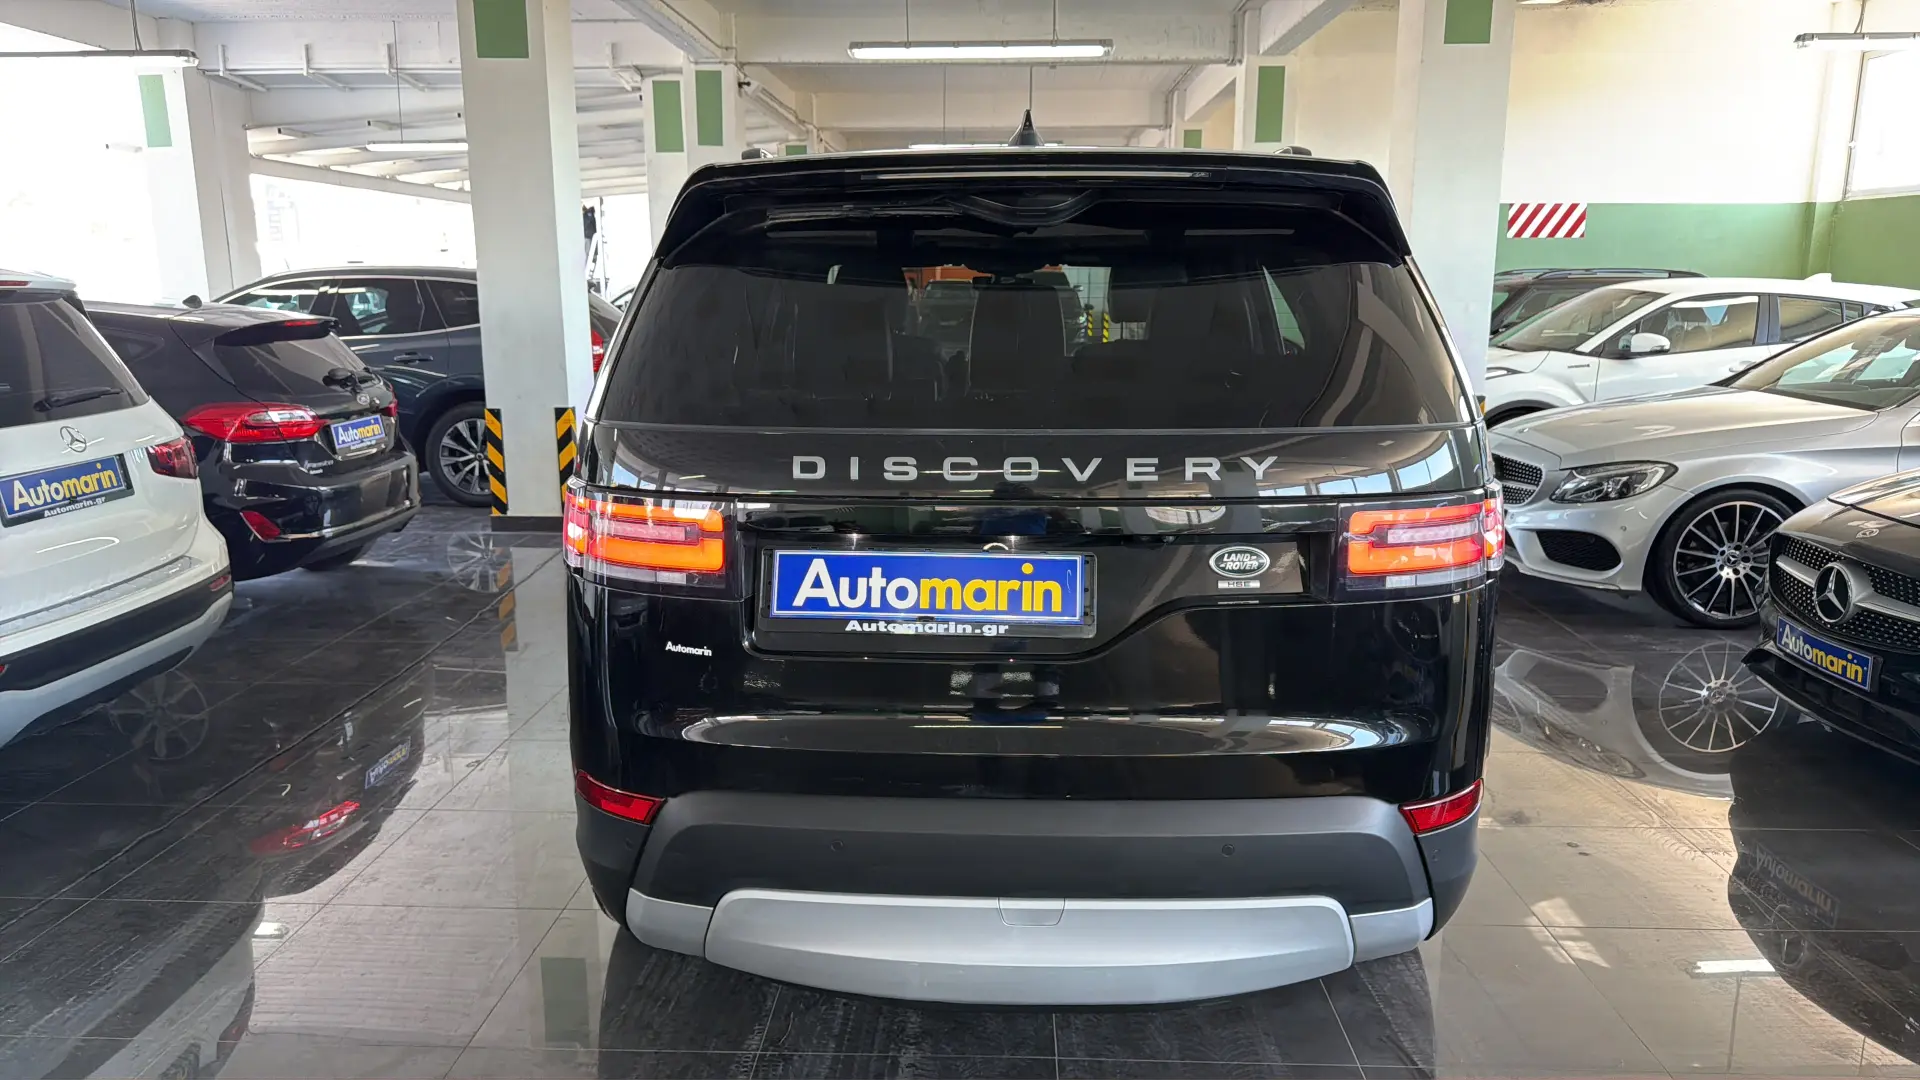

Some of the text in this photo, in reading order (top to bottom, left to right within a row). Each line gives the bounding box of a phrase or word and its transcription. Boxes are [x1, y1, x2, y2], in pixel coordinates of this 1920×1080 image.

[792, 456, 1278, 481] DISCOVERY
[13, 462, 117, 511] Automarin
[44, 496, 106, 517] Automarin.gr
[1225, 561, 1258, 570] ROVER
[792, 558, 1062, 611] Automarin
[845, 620, 1009, 635] Automarin.gr
[665, 641, 712, 656] Automarin
[1781, 623, 1863, 683] Automarin
